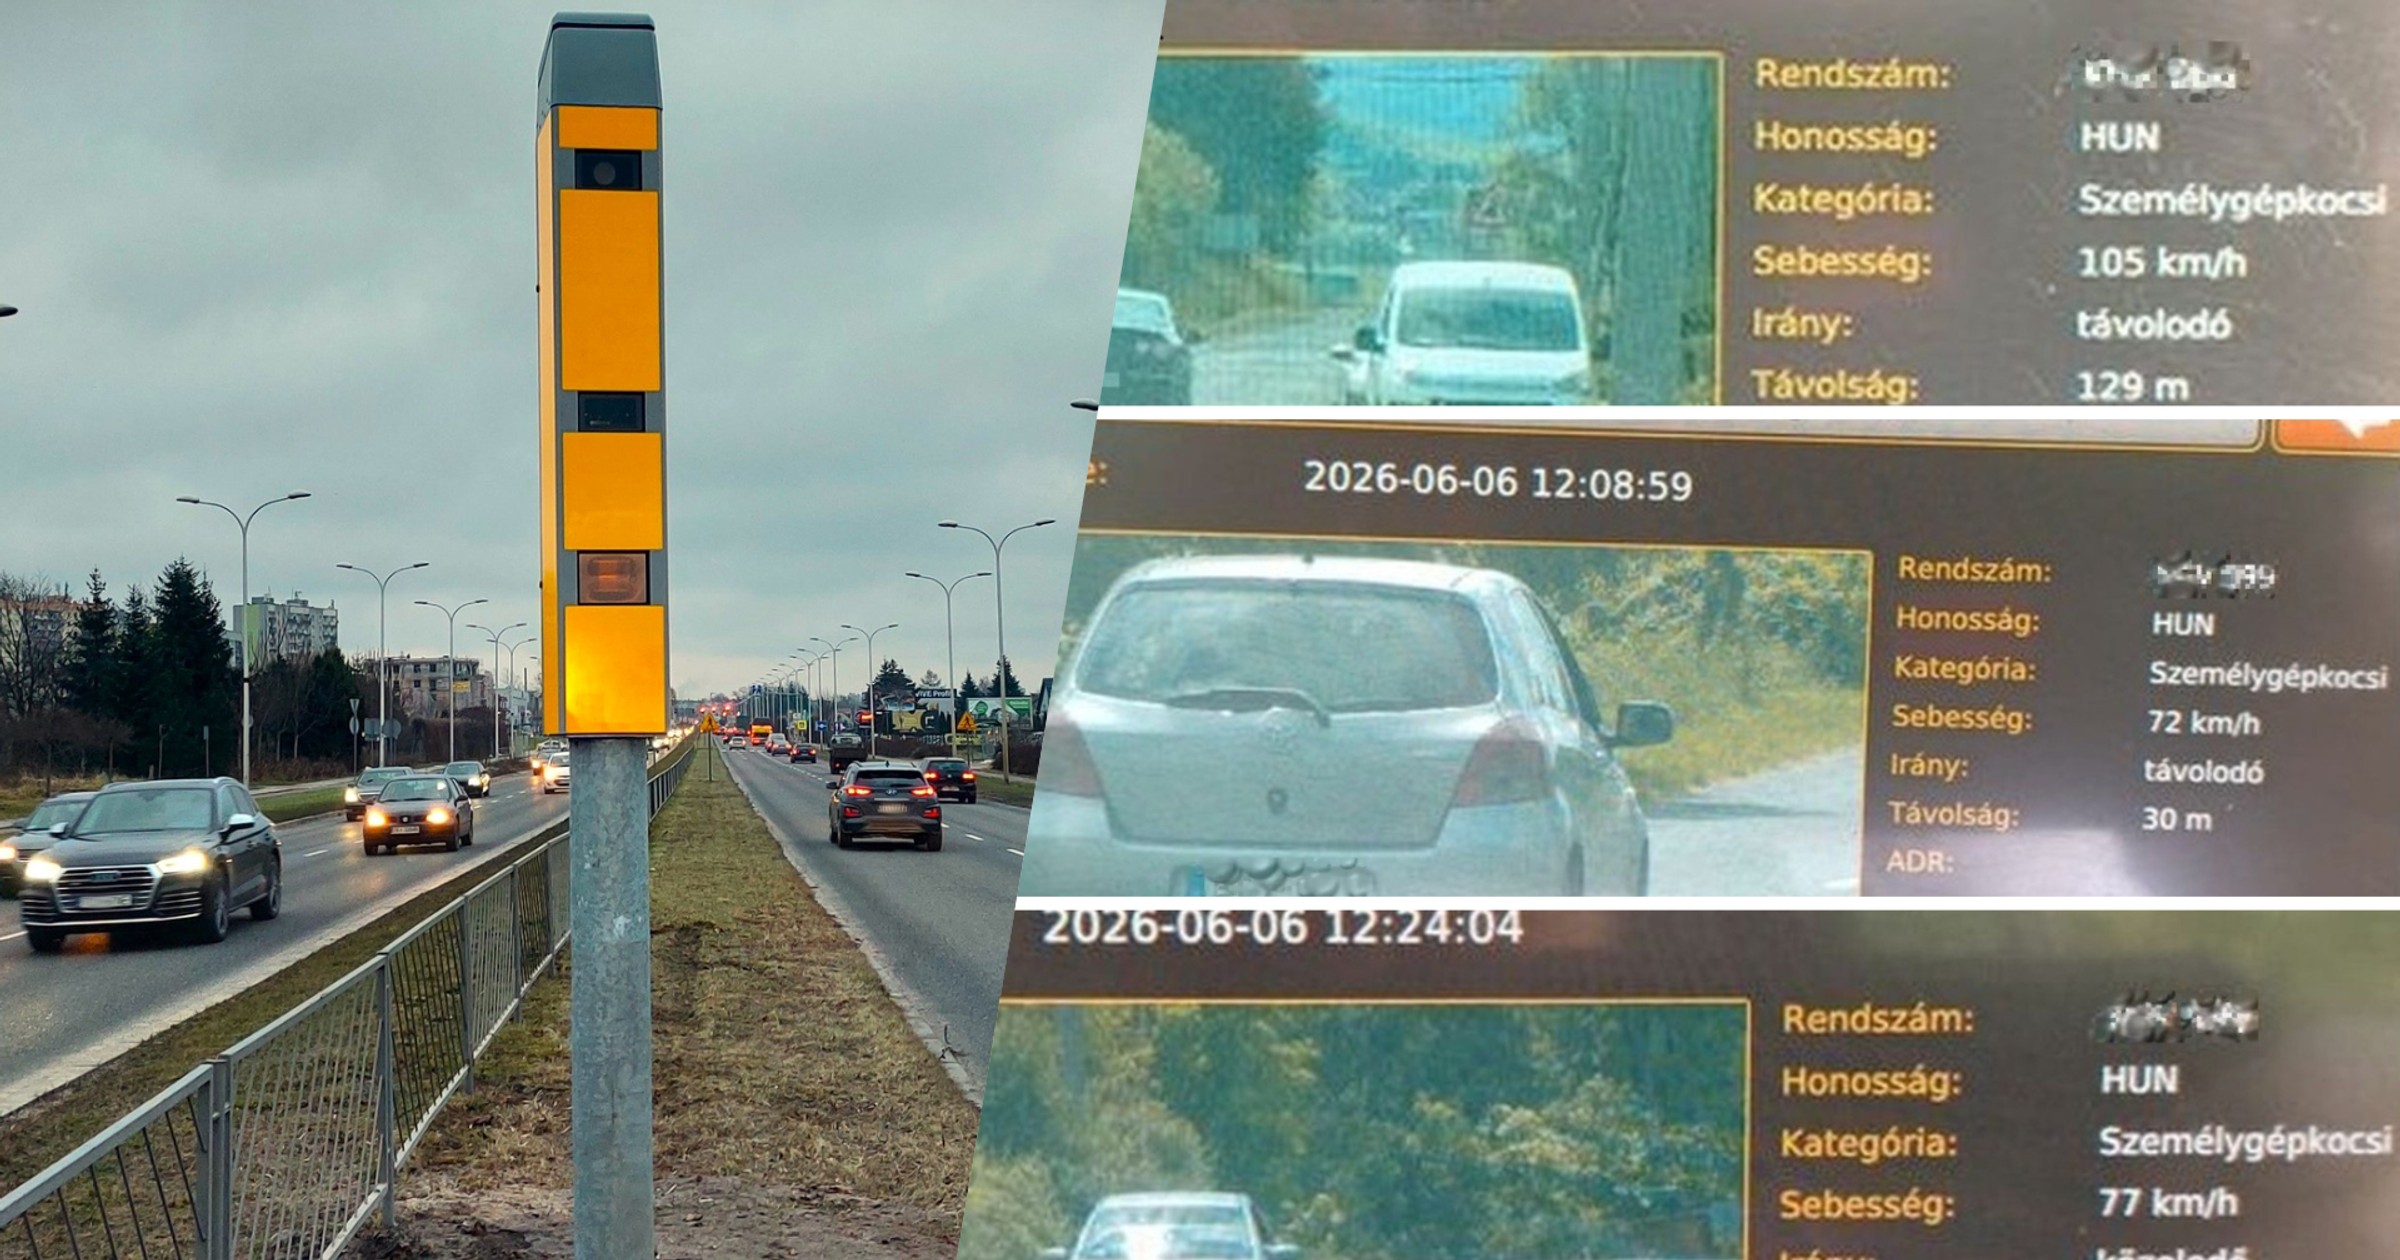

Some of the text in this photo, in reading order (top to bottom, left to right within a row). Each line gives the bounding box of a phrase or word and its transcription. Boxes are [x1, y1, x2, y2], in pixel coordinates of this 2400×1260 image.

[1756, 59, 1950, 89] Rendszám:
[1755, 121, 1938, 158] Honosság:
[2081, 123, 2161, 151] HUN
[1753, 184, 1933, 219] Kategória:
[2079, 183, 2387, 220] Személygépkocsi
[1753, 246, 1932, 282] Sebesség:
[2080, 246, 2247, 280] 105 km/h
[1753, 308, 1852, 342] Irány:
[2077, 309, 2232, 340] távolodó
[1752, 370, 1918, 405] Távolság:
[2078, 371, 2190, 401] 129 m
[1303, 460, 1693, 502] 2026-06-06 12:08:59
[1899, 555, 2051, 583] Rendszám:
[1897, 606, 2040, 635] Honosság:
[2152, 612, 2214, 636] HUN
[1895, 656, 2035, 684] Kategória:
[2149, 661, 2388, 693] Személygépkocsi
[1893, 705, 2032, 733] Sebesség:
[2148, 709, 2261, 737] 72 km/h
[1891, 753, 1968, 780] Irány:
[2144, 758, 2265, 784] távolodó
[1888, 802, 2019, 830] Távolság:
[2142, 806, 2213, 831] 30 m
[1887, 850, 1954, 874] ADR:
[1043, 910, 1524, 944] 2026-06-06 12:24:04
[1784, 1005, 1973, 1034] Rendszám:
[1783, 1067, 1962, 1102] Honosság:
[2102, 1065, 2178, 1095] HUN
[1782, 1129, 1956, 1164] Kategória:
[2099, 1125, 2393, 1161] Személygépkocsi
[1780, 1190, 1954, 1226] Sebesség:
[2099, 1187, 2239, 1220] 77 km/h
